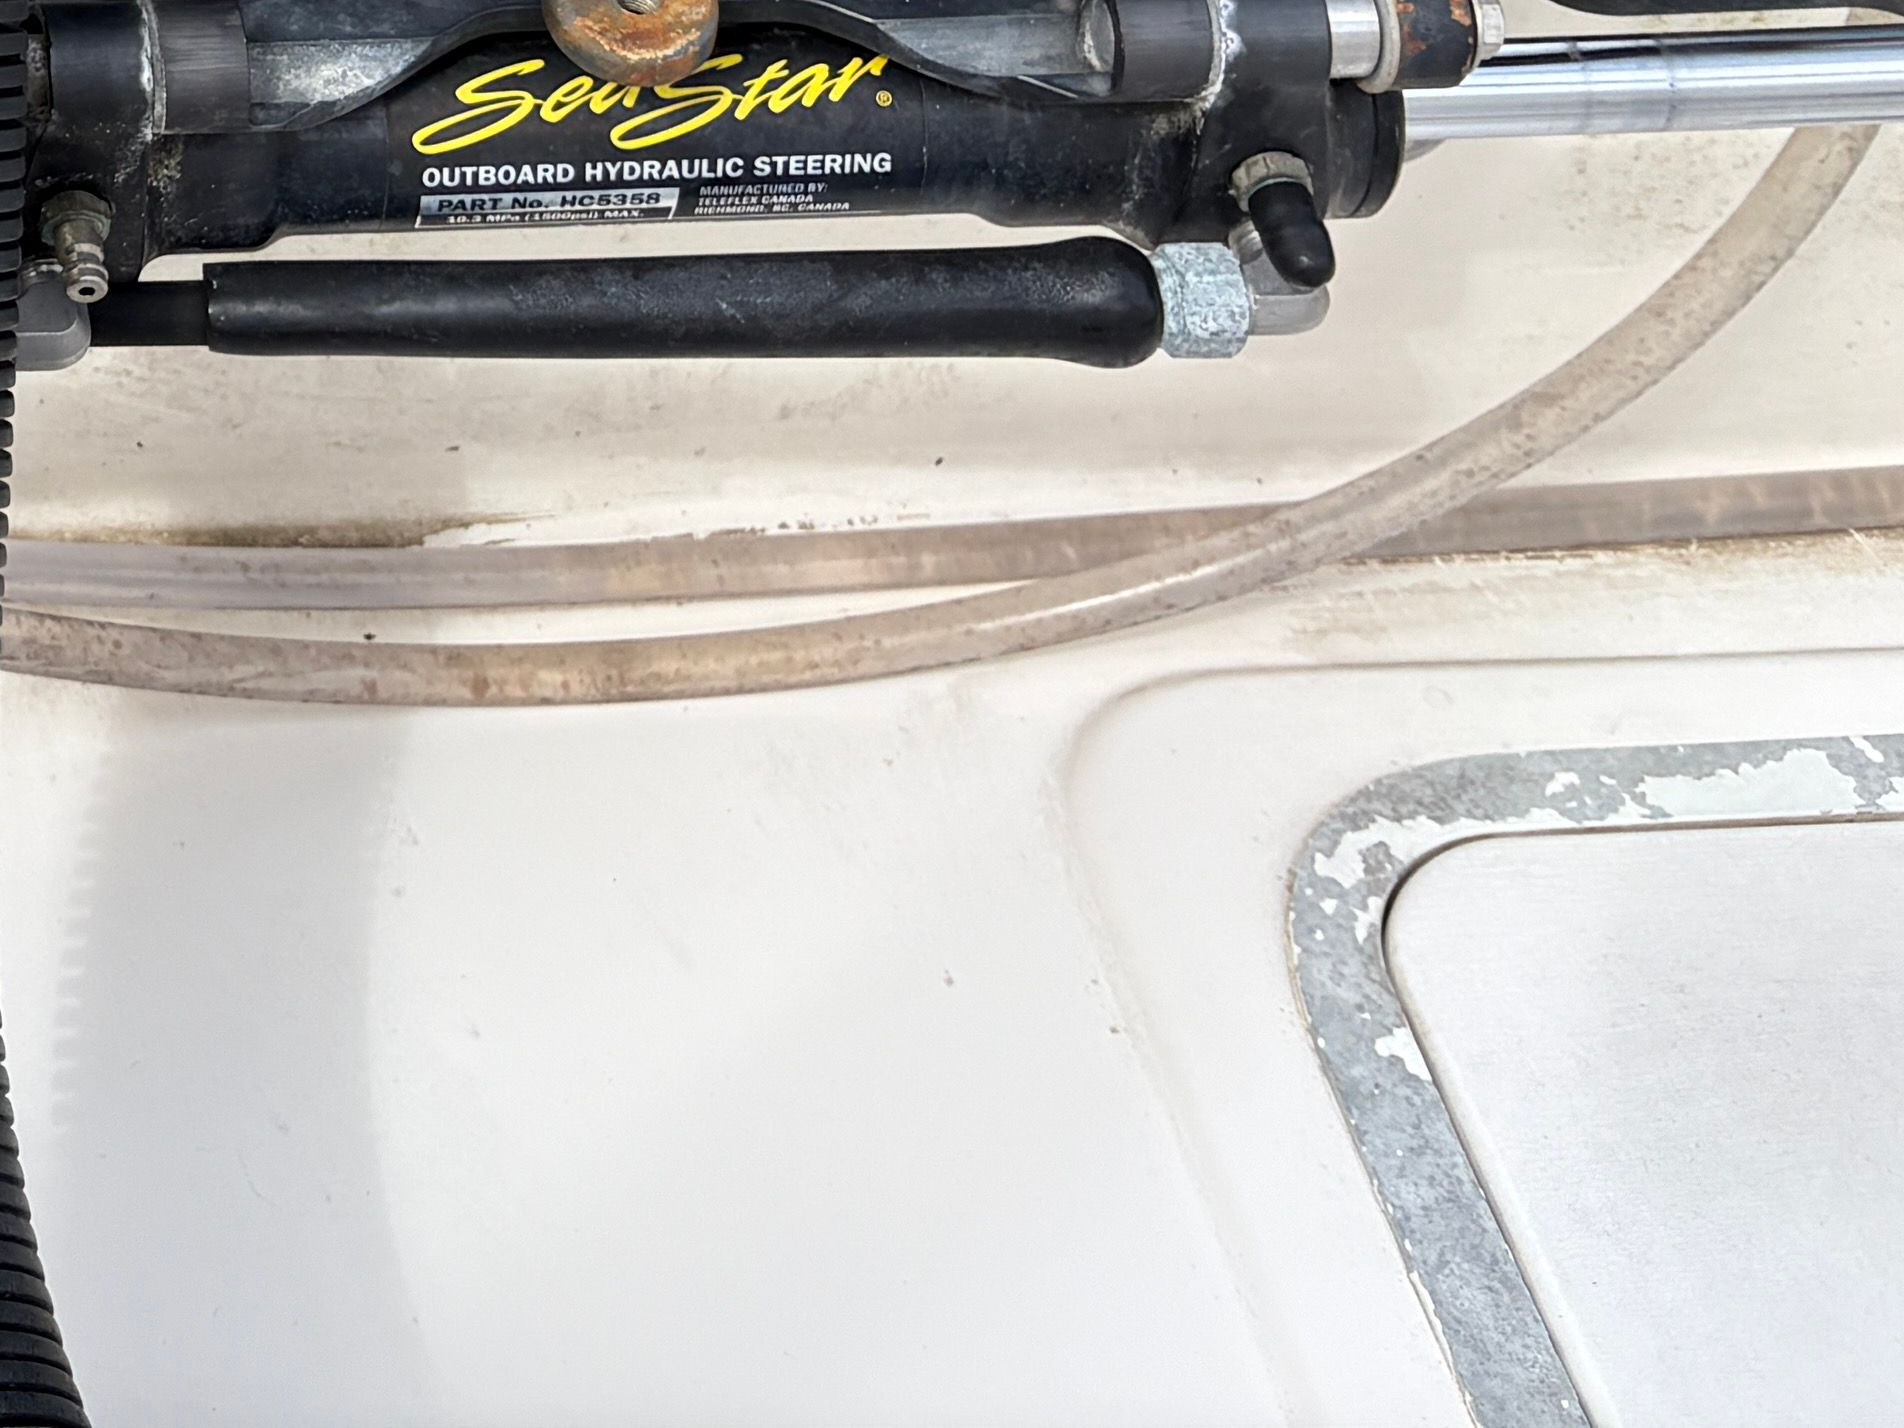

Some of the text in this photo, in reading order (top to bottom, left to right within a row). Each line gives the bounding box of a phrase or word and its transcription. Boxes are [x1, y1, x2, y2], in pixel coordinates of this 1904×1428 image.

[422, 152, 892, 188] OUTBOARD HYDRAULIC STEERING
[699, 183, 804, 196] MANUFACTURED
[437, 192, 661, 212] PART No. HC5358
[698, 194, 813, 206] TELEFLEX CANADA
[798, 202, 850, 212] CANADA
